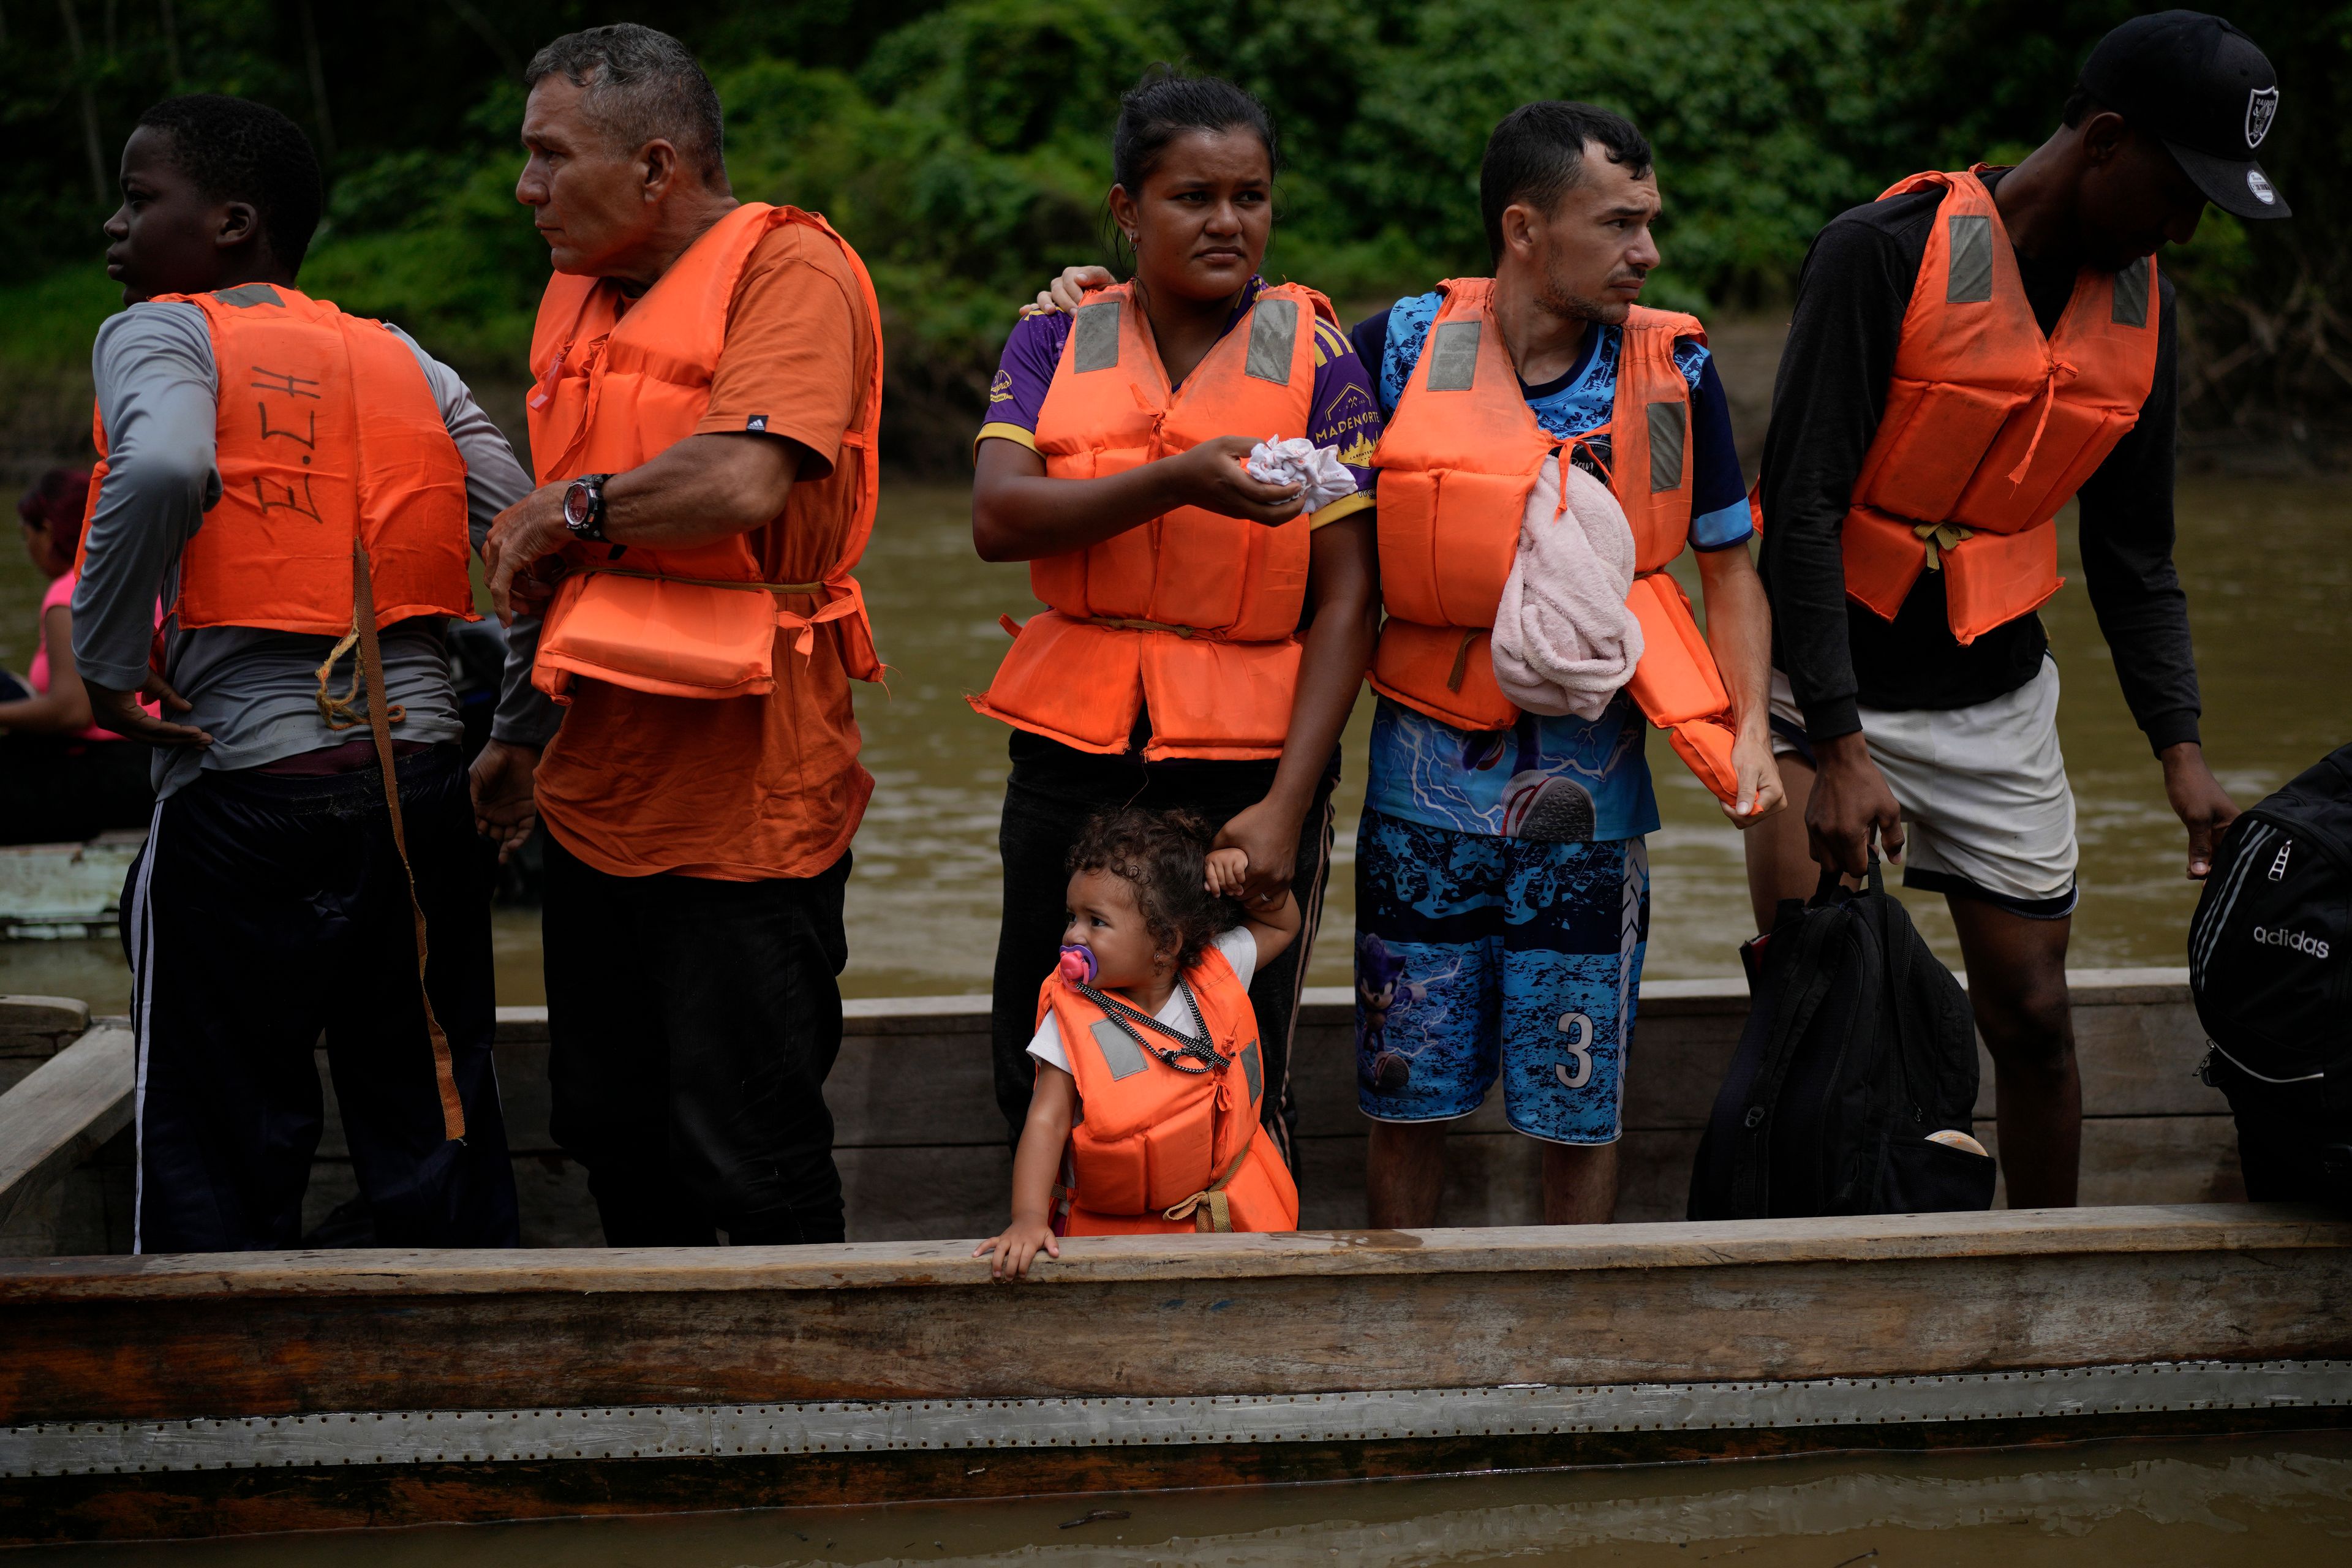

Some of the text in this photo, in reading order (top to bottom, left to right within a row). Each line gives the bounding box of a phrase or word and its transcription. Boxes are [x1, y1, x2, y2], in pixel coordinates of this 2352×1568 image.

[1315, 411, 1380, 443] MADENORTE
[1349, 450, 1374, 460] CARPINTERI
[2253, 926, 2329, 959] adidas
[1554, 1012, 1594, 1088] 3
